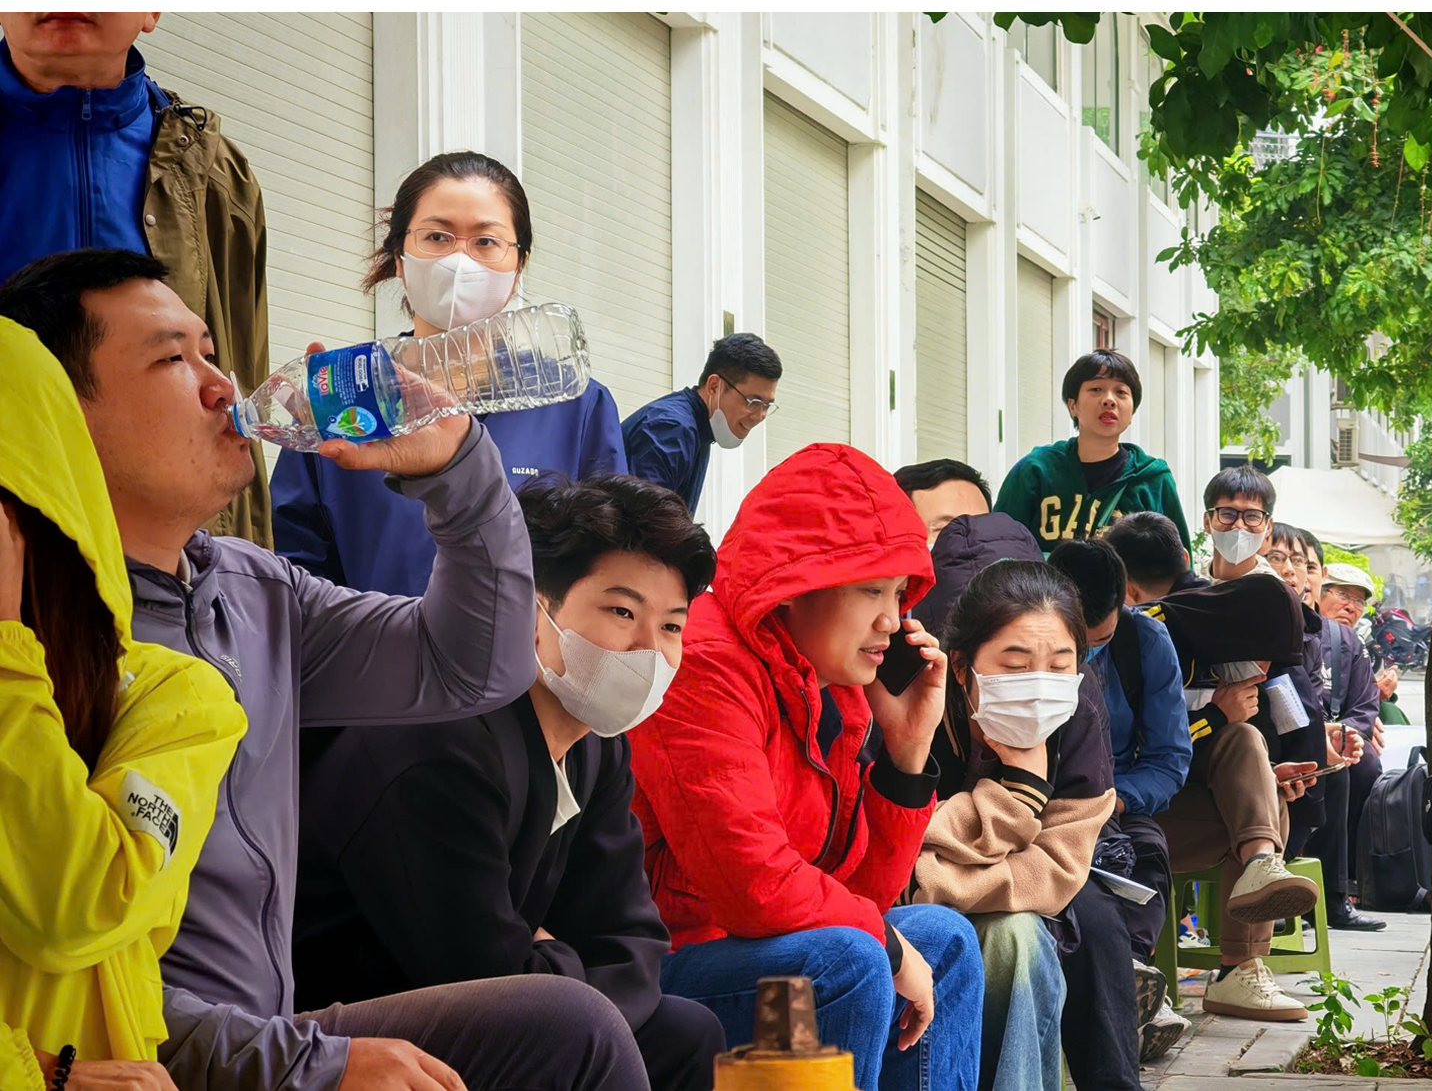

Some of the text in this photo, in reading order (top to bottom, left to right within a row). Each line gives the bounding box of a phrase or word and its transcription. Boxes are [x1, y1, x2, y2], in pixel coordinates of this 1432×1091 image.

[127, 792, 171, 827] NORTH
[136, 806, 166, 835] FACE
[154, 794, 173, 818] THE
